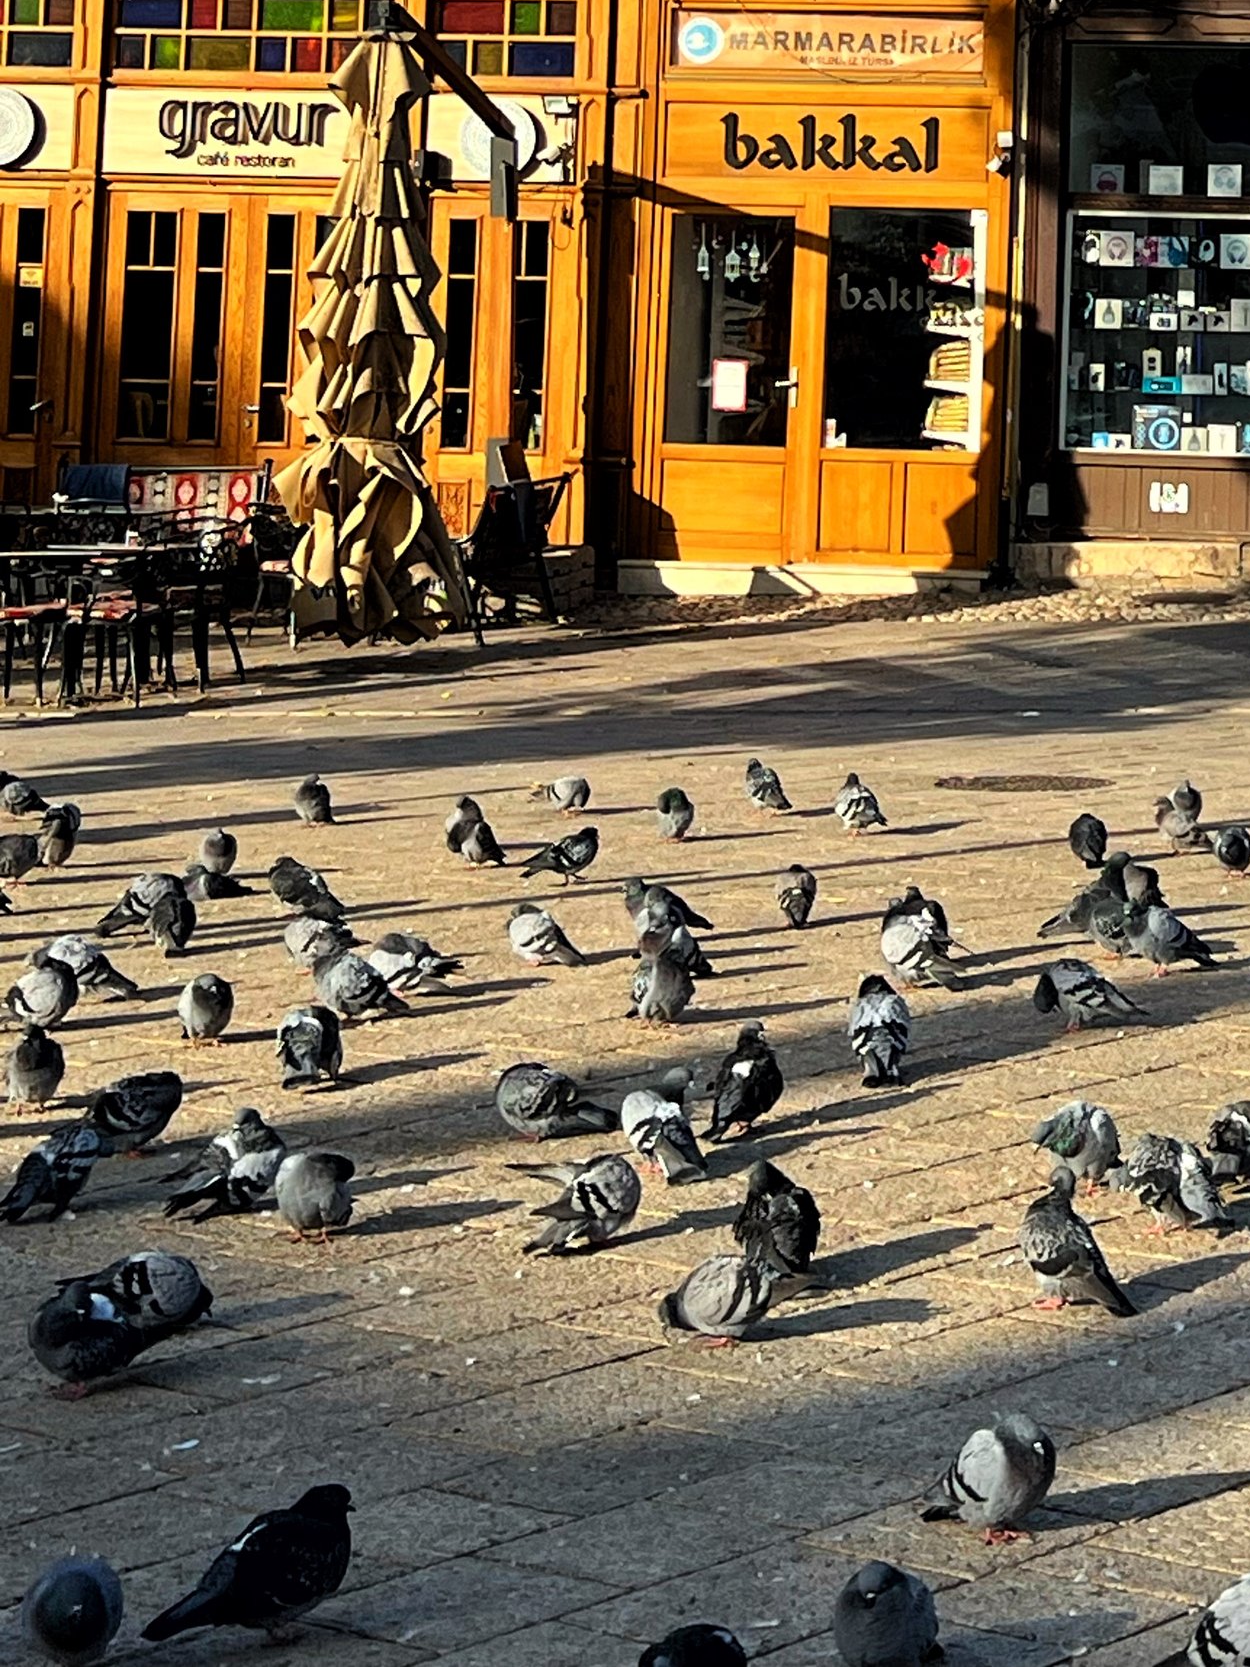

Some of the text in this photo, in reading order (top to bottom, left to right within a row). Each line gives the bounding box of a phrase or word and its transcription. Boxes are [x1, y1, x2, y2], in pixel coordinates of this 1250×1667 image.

[728, 29, 976, 55] MARMARABİRLİK
[159, 99, 341, 159] gravur
[720, 112, 940, 173] bakkal
[197, 151, 296, 168] café restoran
